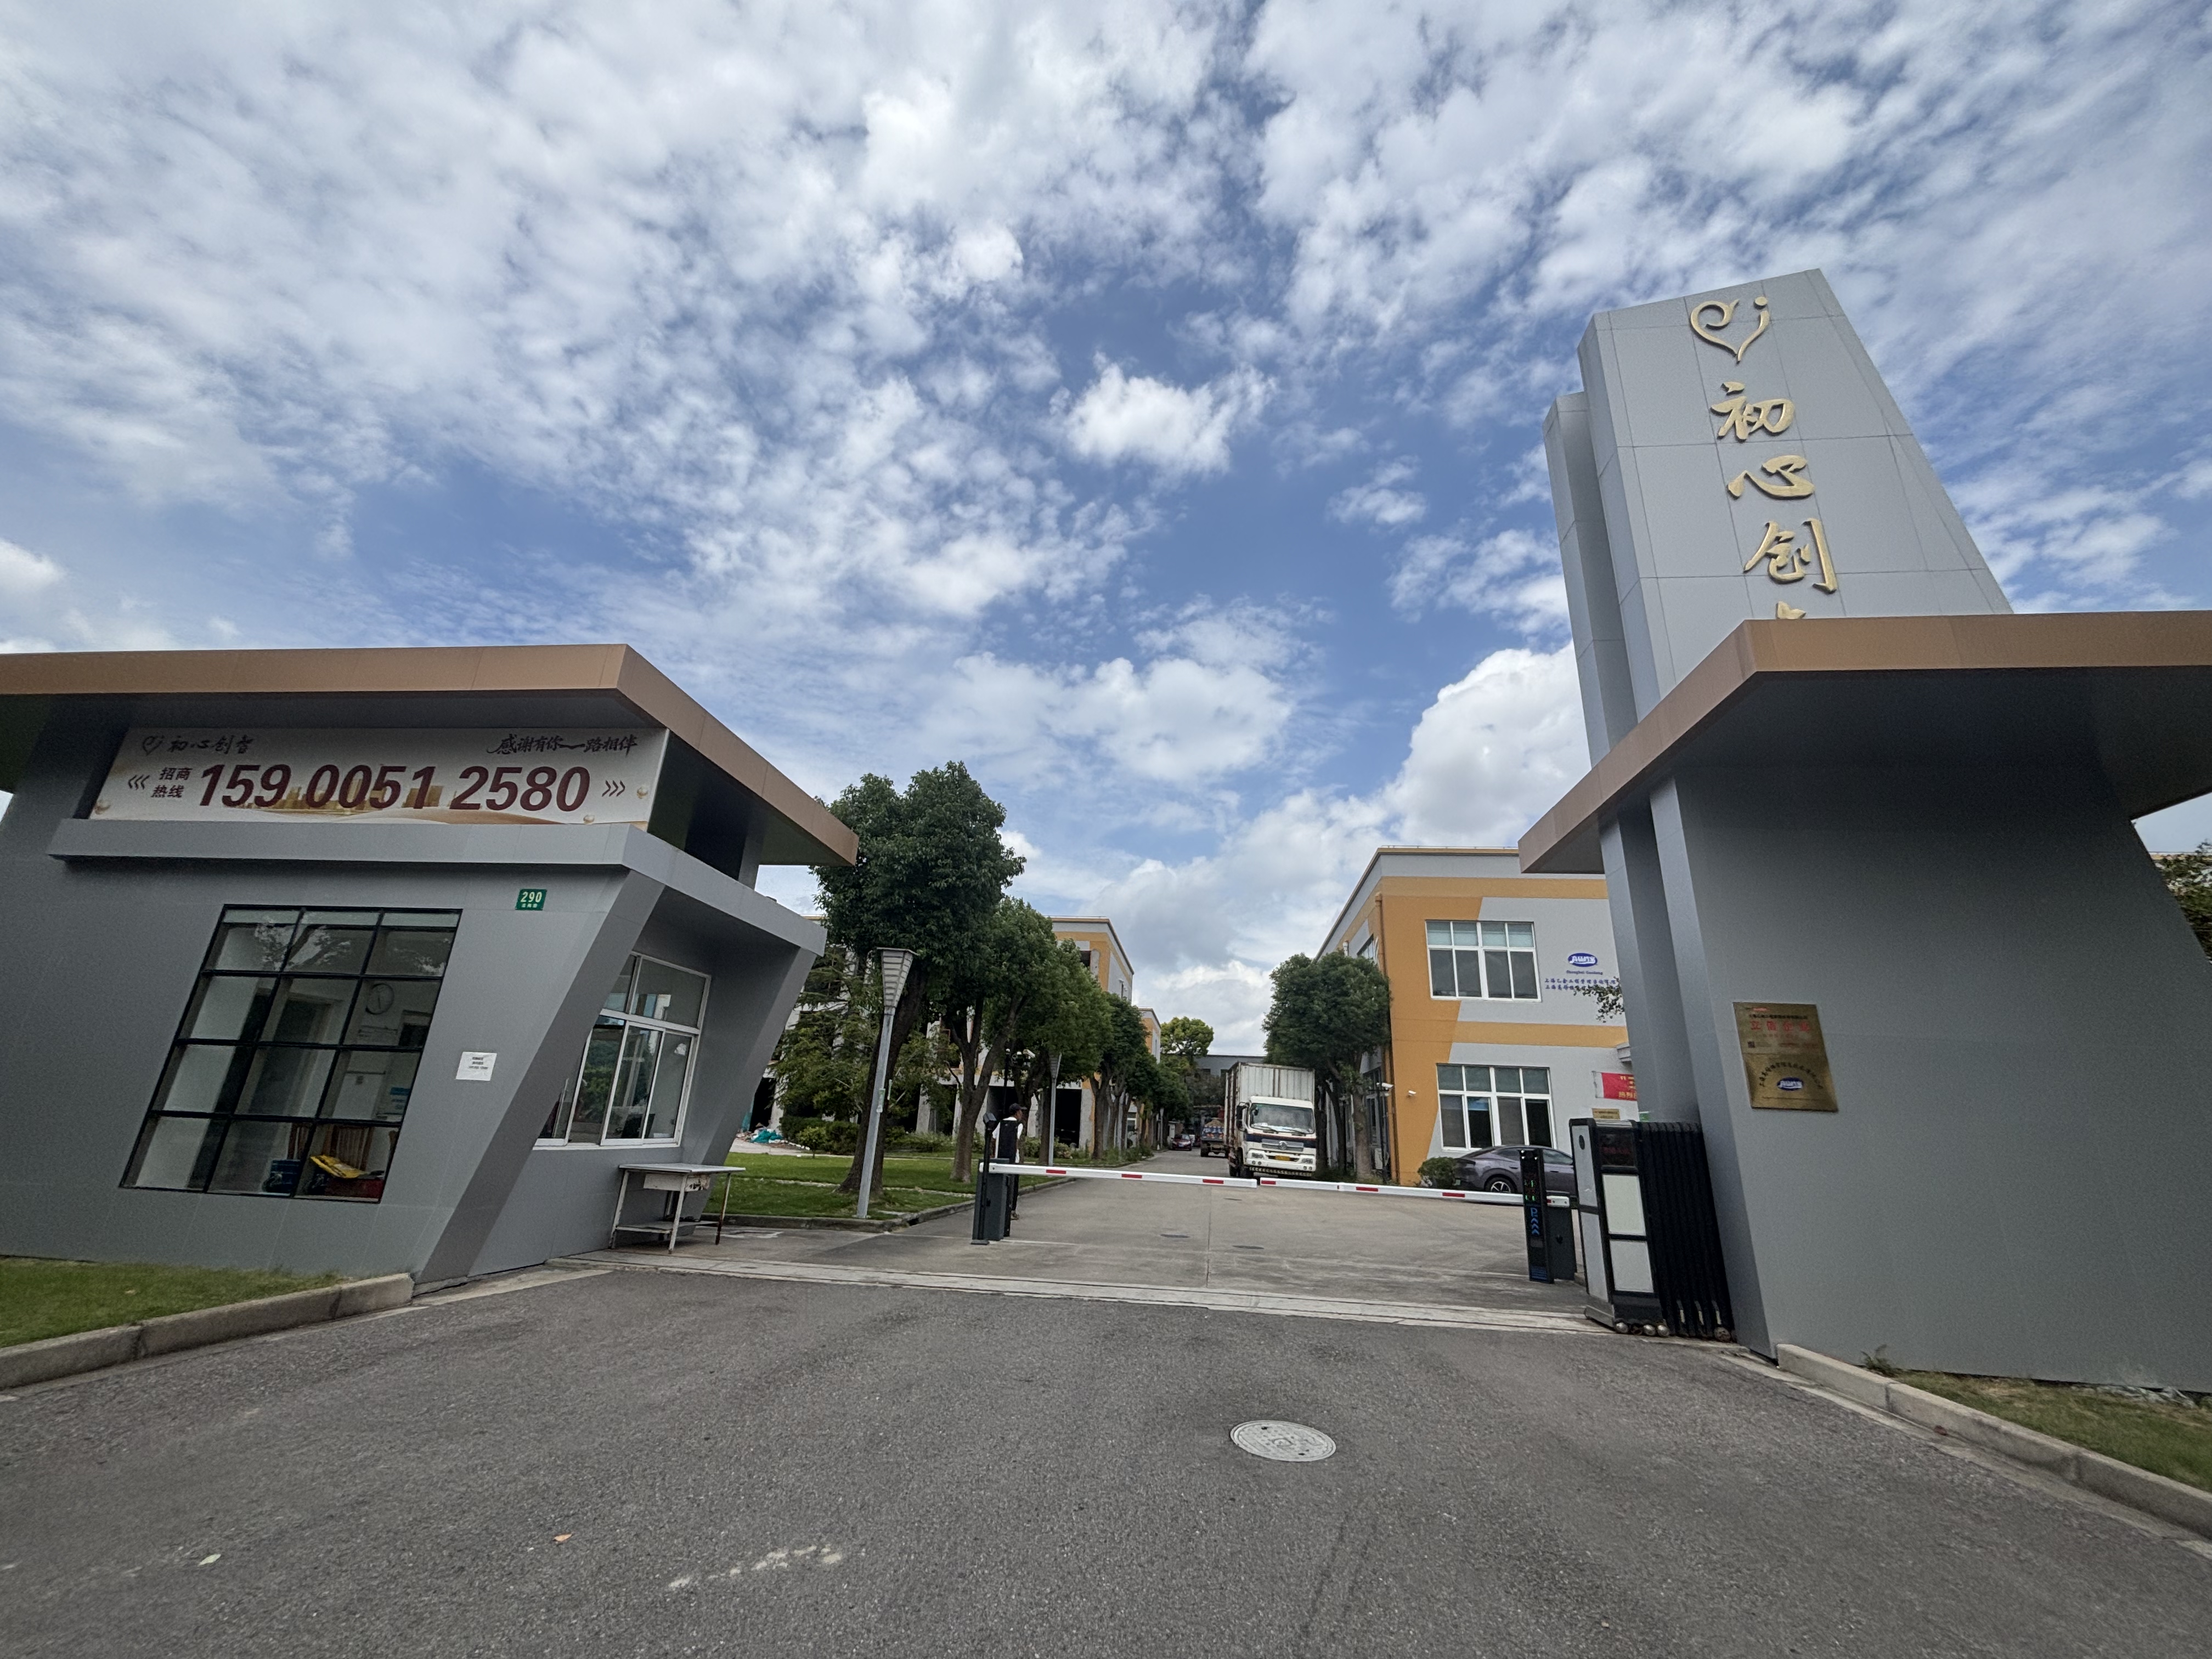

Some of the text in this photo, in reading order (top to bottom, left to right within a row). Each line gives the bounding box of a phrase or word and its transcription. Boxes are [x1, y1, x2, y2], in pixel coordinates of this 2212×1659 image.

[1711, 381, 1838, 620] 初心创
[487, 733, 638, 757] 感谢有你一路相伴
[159, 768, 193, 781] 招商
[150, 785, 185, 799] 热线
[200, 764, 590, 812] 159 0051 2580
[520, 891, 542, 902] 290
